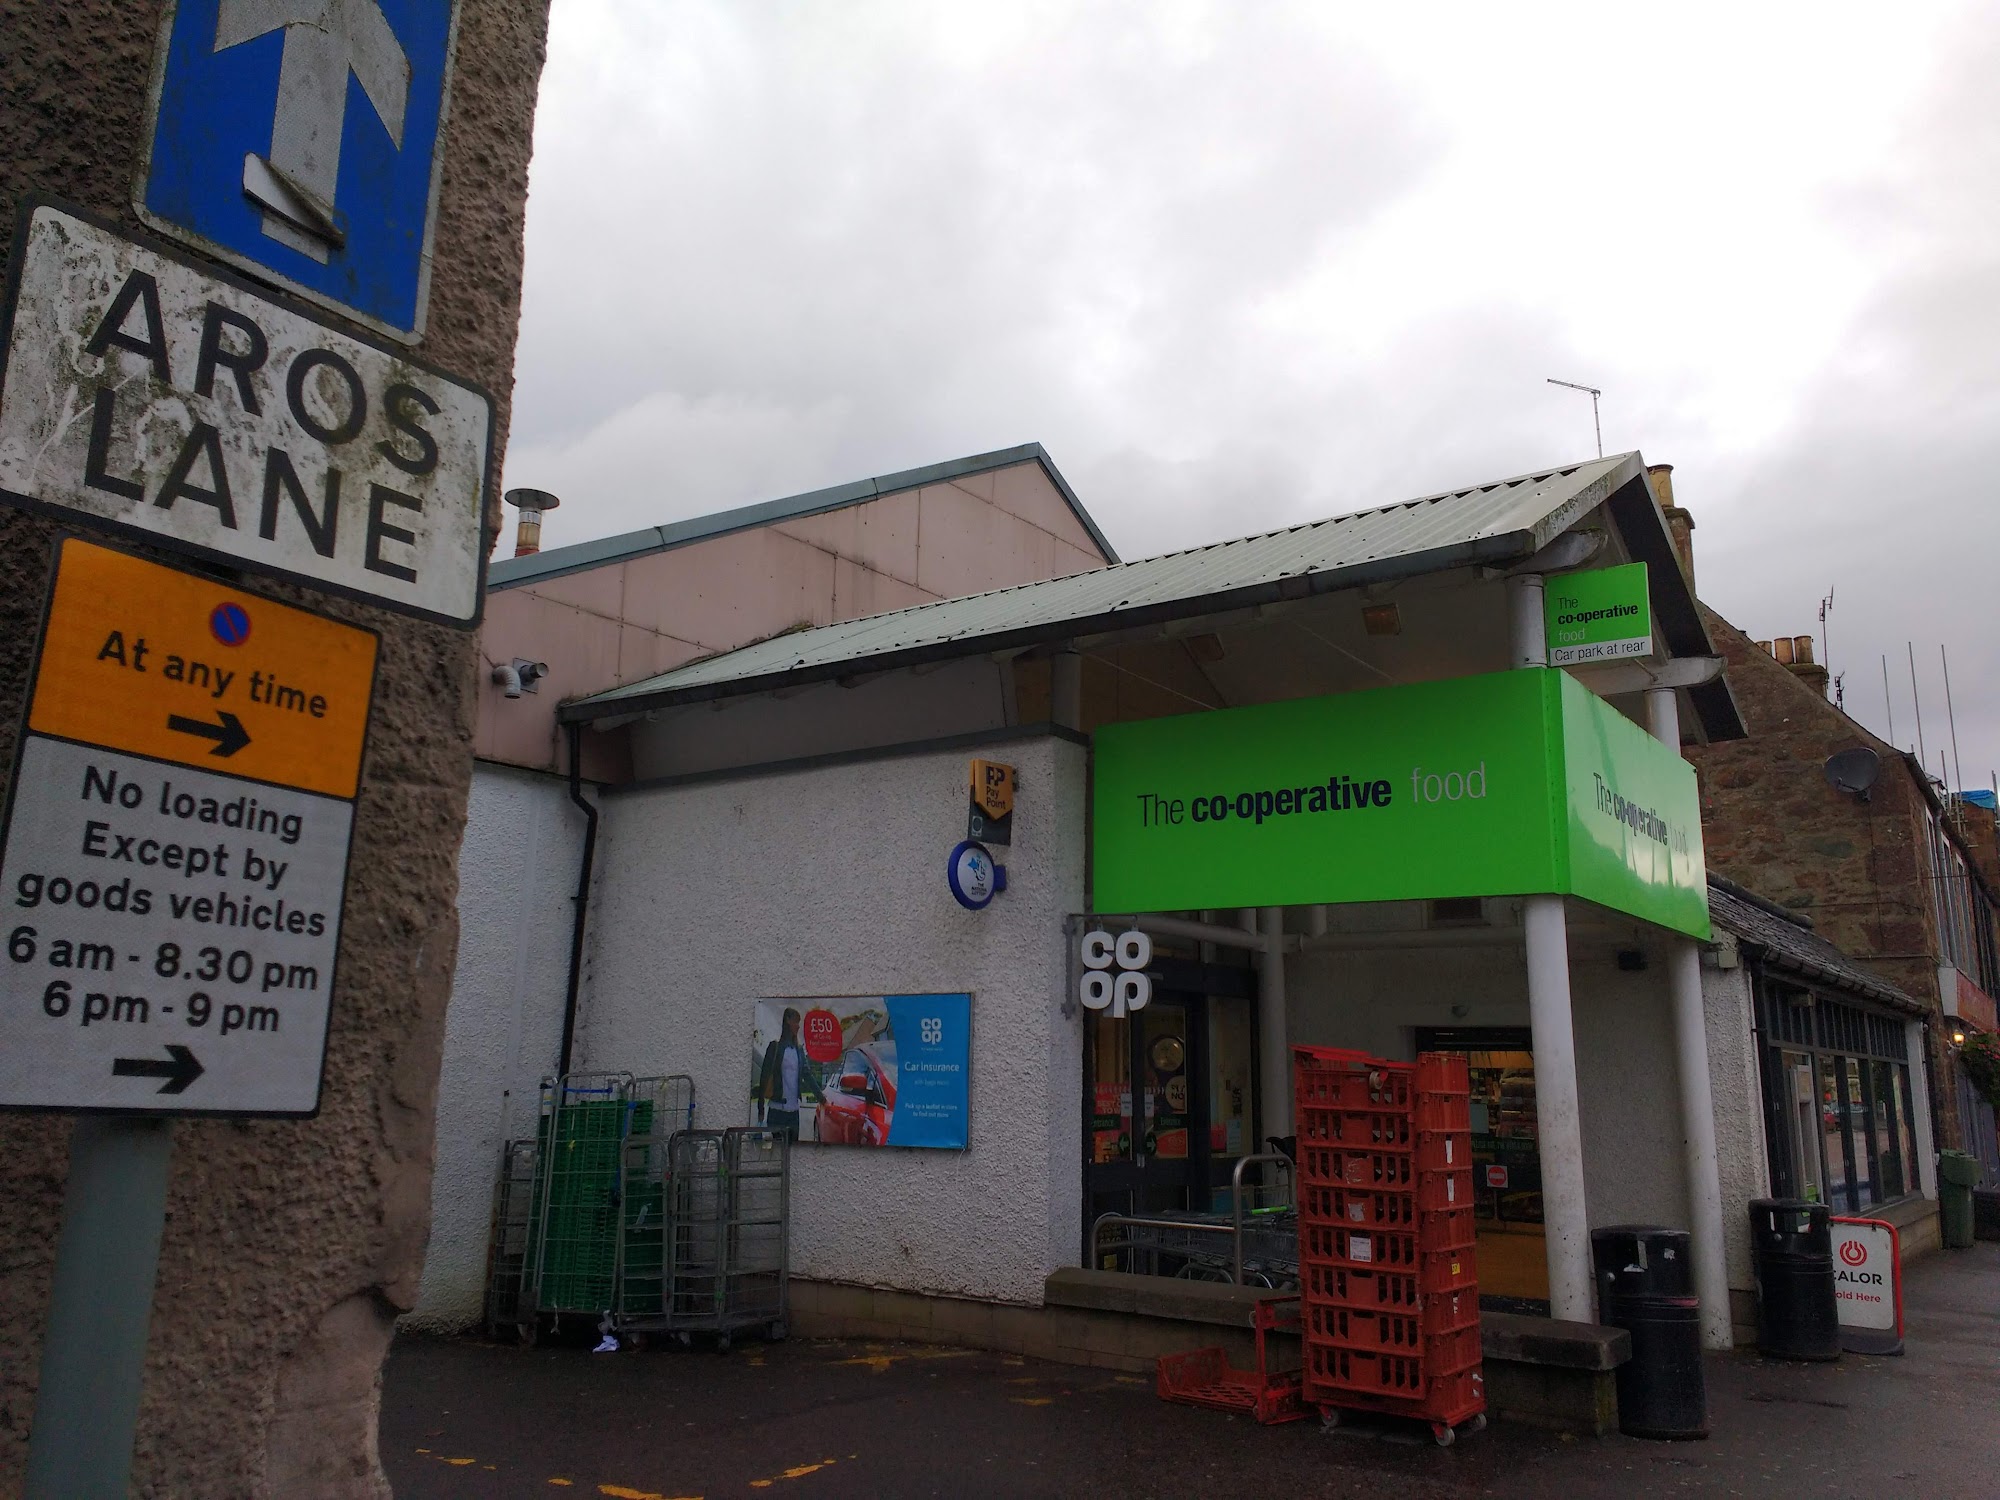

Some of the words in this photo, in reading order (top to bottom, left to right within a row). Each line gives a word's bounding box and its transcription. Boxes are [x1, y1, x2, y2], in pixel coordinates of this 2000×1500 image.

[86, 268, 441, 475] AROS
[84, 388, 422, 583] LANE
[1557, 596, 1579, 609] The
[1557, 603, 1639, 625] co-operative
[1554, 648, 1575, 662] Car
[1577, 646, 1604, 662] park
[1606, 643, 1618, 655] at
[1621, 640, 1645, 653] rear
[1558, 628, 1585, 642] food
[97, 630, 149, 672] At
[164, 655, 234, 699] any
[249, 670, 328, 719] time
[81, 766, 143, 810] No
[159, 781, 303, 843] loading
[986, 786, 1000, 800] Pay
[986, 797, 1006, 810] Point
[1137, 794, 1184, 827] The
[1191, 776, 1392, 824] co-operative
[1410, 761, 1486, 803] food
[1593, 772, 1612, 815] The
[1613, 793, 1667, 845] co-operative
[81, 821, 228, 878] Except
[244, 847, 288, 890] by
[15, 872, 152, 915] goods
[170, 886, 326, 937] vehicles
[8, 926, 37, 963] 6
[49, 942, 115, 972] am
[154, 943, 253, 985] 8.30
[262, 960, 318, 993] pm
[43, 980, 70, 1018] 6
[81, 993, 149, 1027] pm
[186, 992, 212, 1028] 9
[220, 1000, 280, 1035] pm
[811, 1018, 833, 1033] £50
[904, 1061, 919, 1071] Car
[920, 1061, 960, 1072] Insurance
[1833, 1270, 1883, 1285] ALOR
[1834, 1290, 1853, 1300] old
[1856, 1292, 1881, 1303] Here
